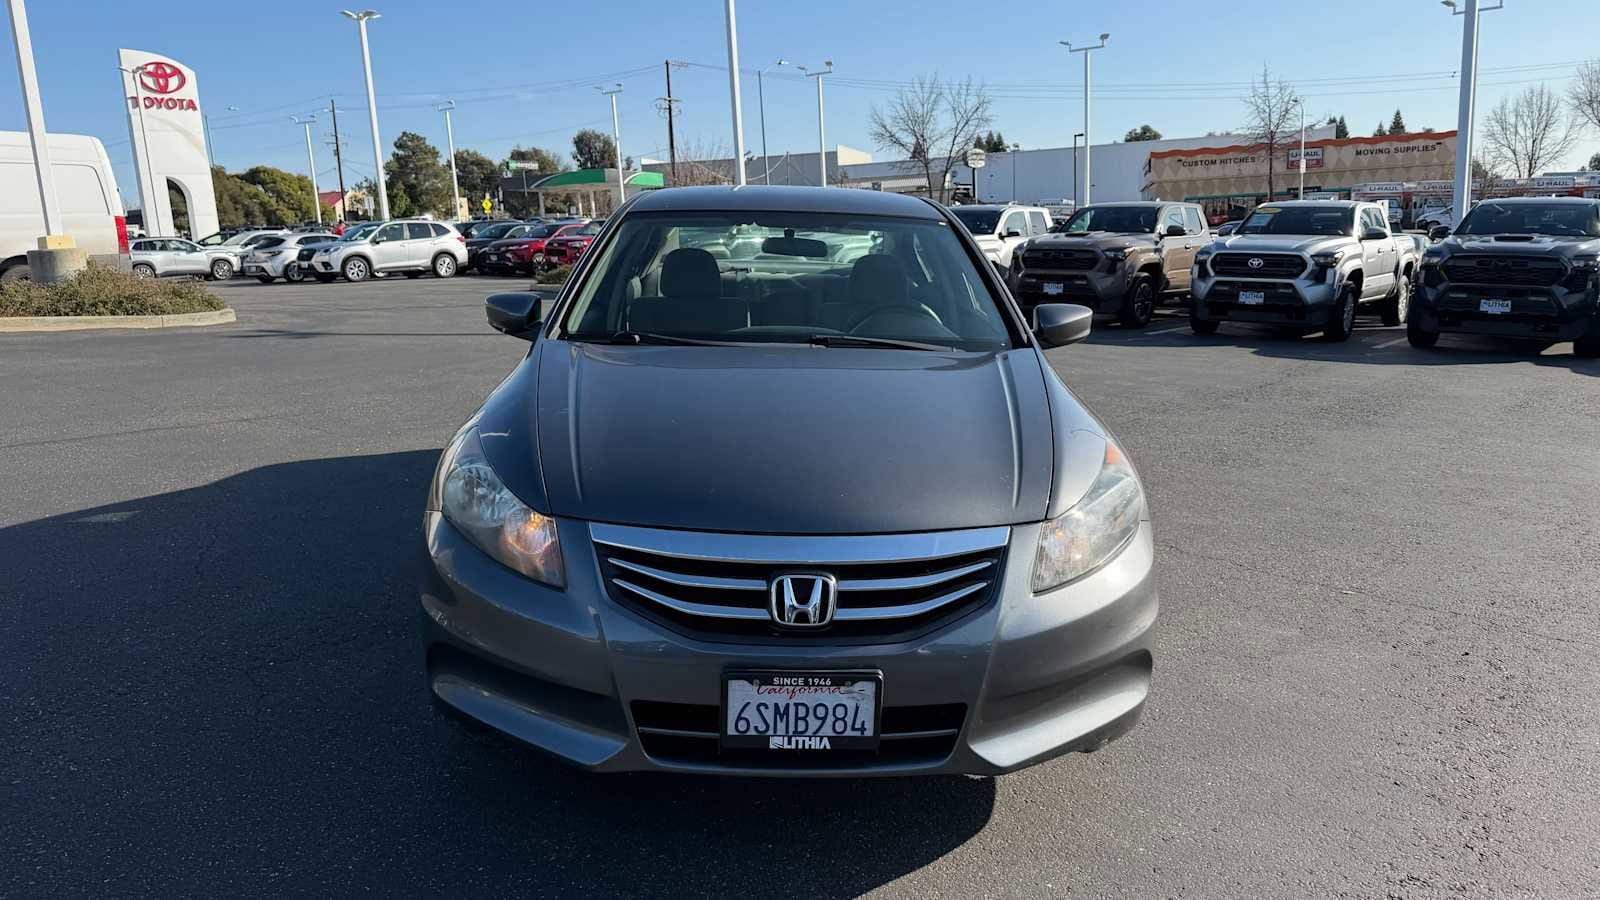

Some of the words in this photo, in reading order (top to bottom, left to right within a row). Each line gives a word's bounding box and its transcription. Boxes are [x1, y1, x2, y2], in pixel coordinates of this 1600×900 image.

[127, 96, 198, 111] TOYOTA
[1355, 147, 1391, 156] MOVING
[1393, 144, 1437, 154] SUPPLIES
[1182, 159, 1217, 167] CUSTOM
[1220, 156, 1256, 165] HITCHES
[773, 677, 804, 686] SINCE
[808, 677, 832, 686] 1946
[734, 702, 867, 735] 6SMB984
[785, 737, 831, 749] LITHIA
